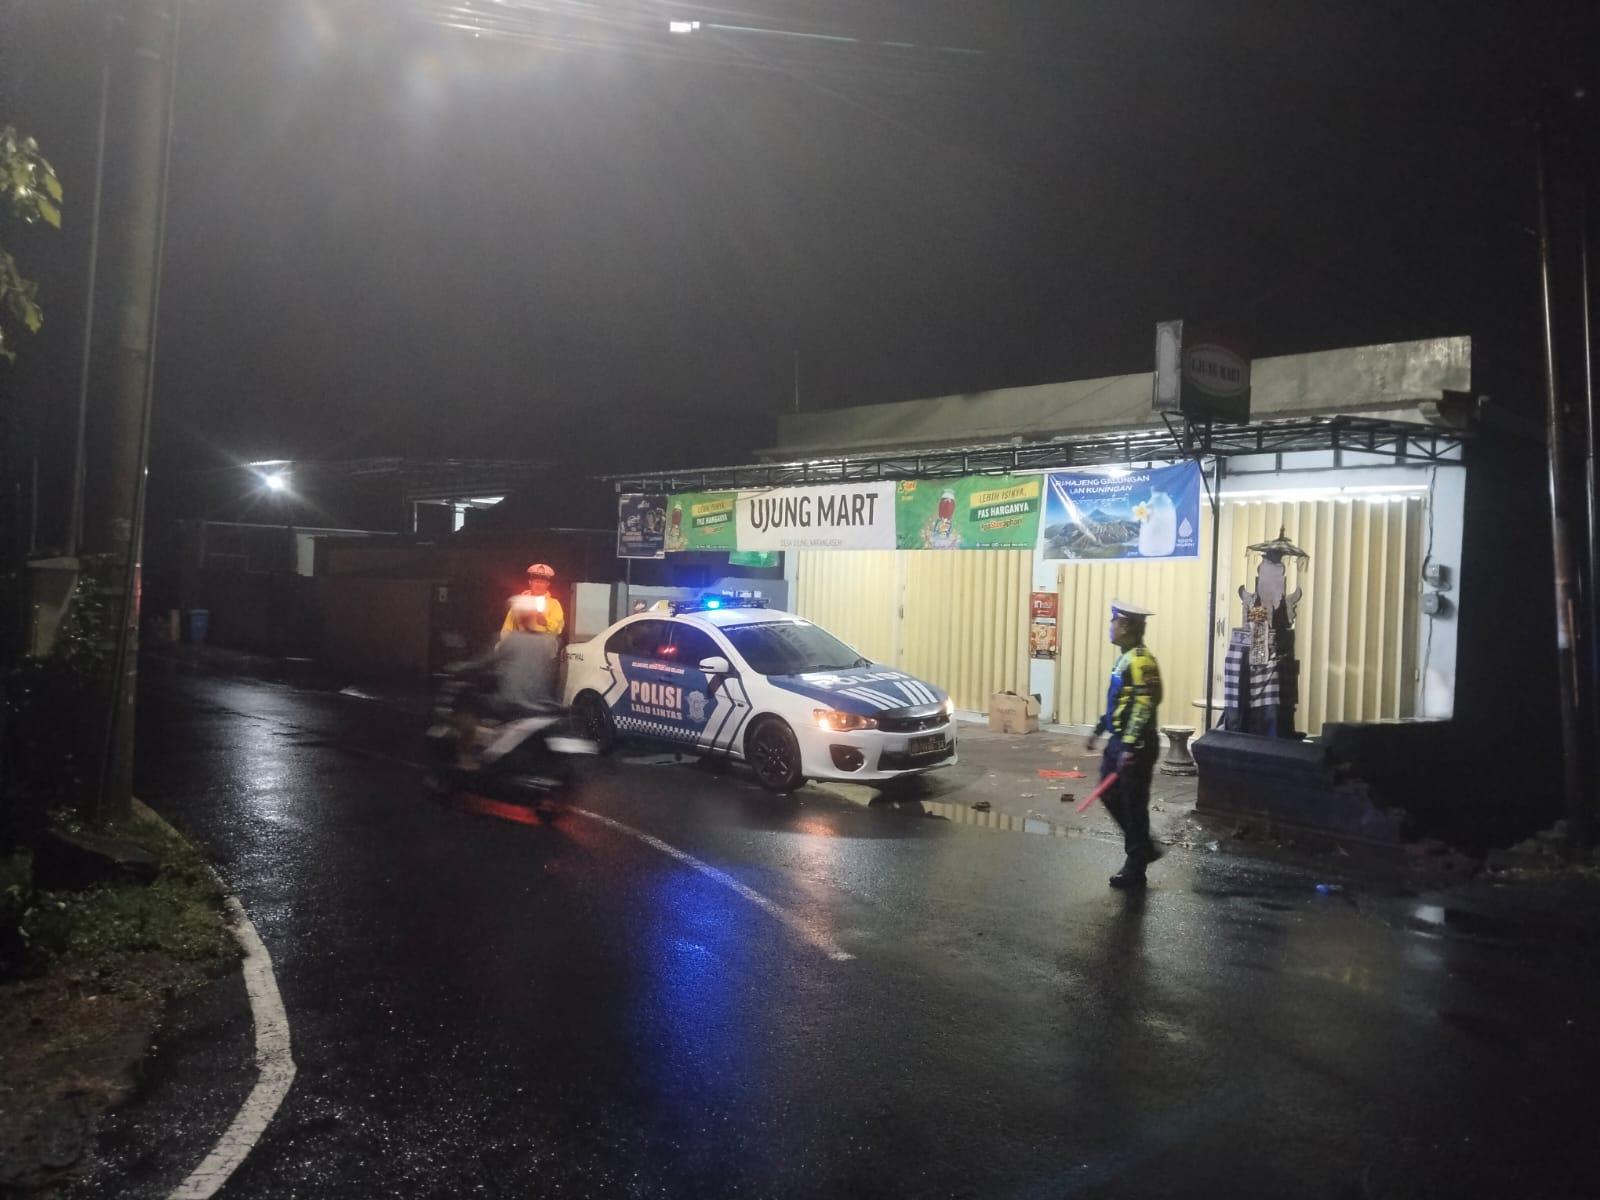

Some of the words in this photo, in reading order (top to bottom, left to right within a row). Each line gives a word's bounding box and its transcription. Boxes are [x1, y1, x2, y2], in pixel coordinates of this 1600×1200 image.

[750, 496, 811, 533] UJUNG
[817, 493, 879, 527] MART
[977, 509, 990, 519] PAS
[990, 502, 1030, 516] HARGANYA
[631, 680, 682, 709] POLISI
[631, 703, 651, 714] LALU
[651, 707, 683, 720] LINTAS
